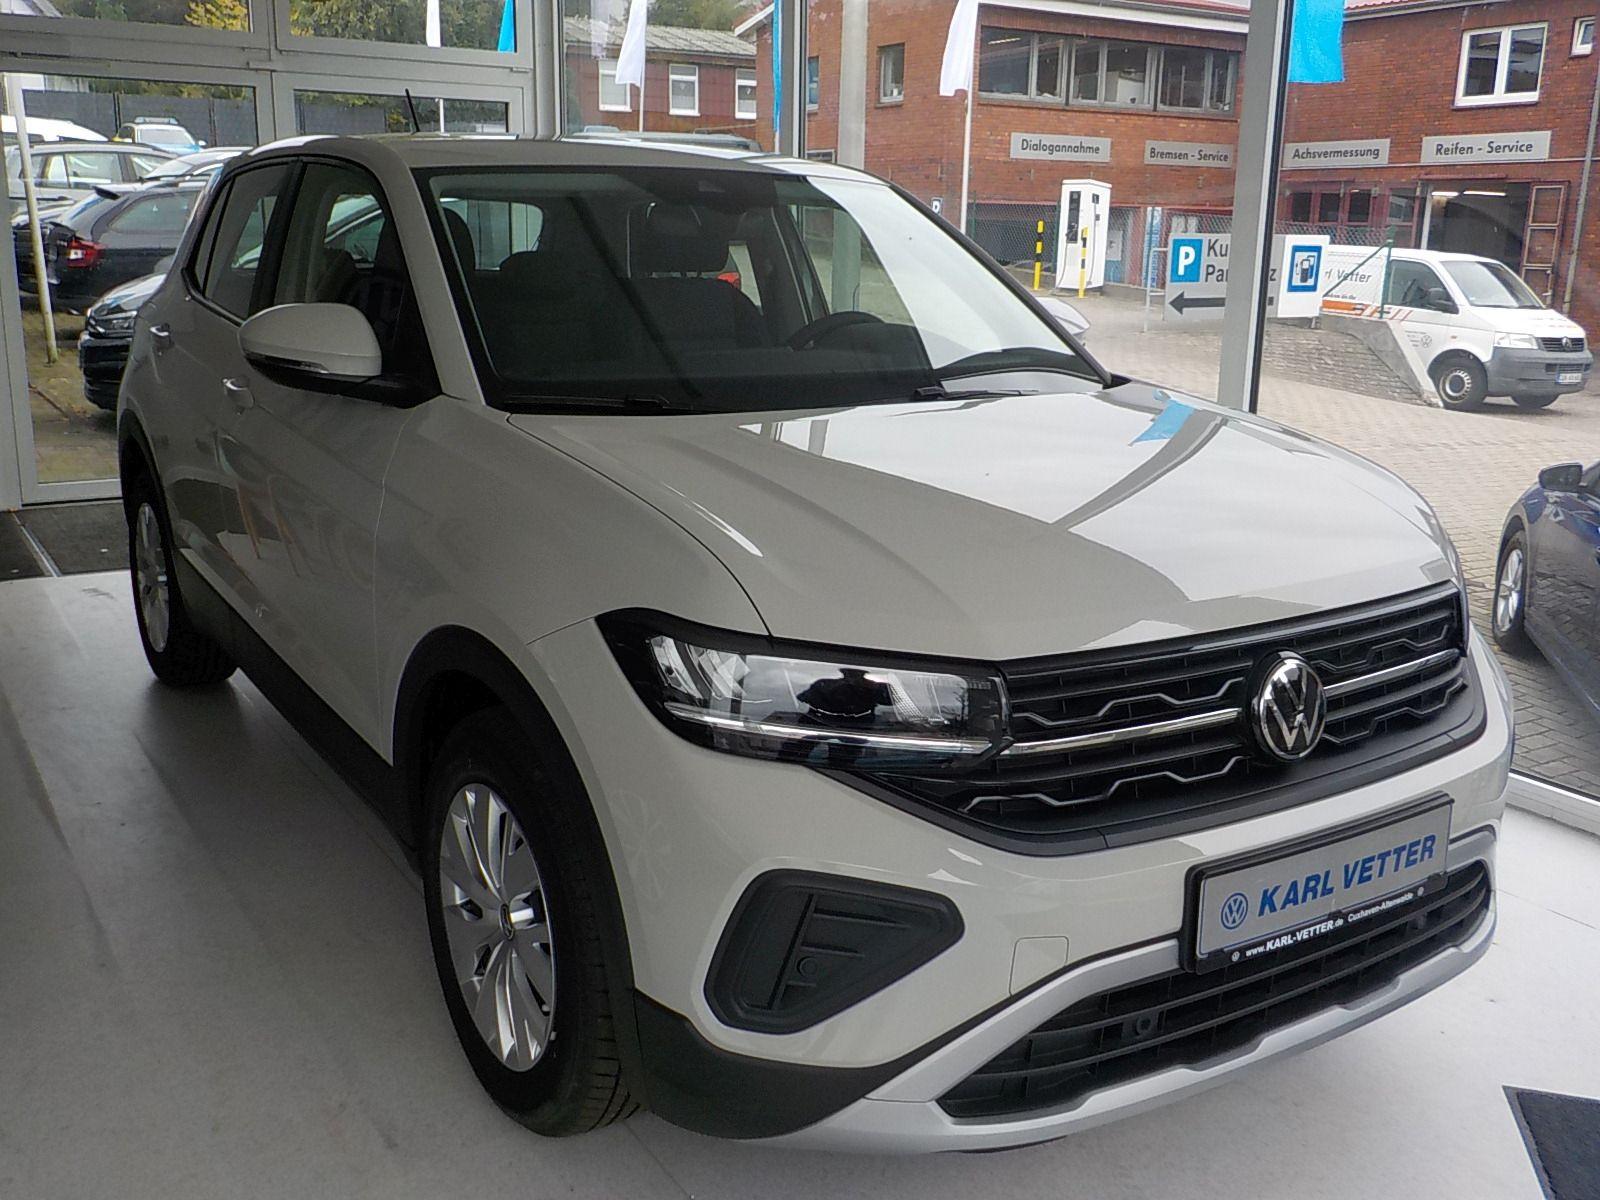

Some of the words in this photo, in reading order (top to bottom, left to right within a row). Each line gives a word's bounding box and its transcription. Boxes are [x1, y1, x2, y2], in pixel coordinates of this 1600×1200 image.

[1021, 138, 1100, 155] Dialogannahme
[1150, 147, 1189, 161] Bremsen
[1197, 149, 1229, 162] Service
[1292, 147, 1380, 160] Achsvermessung
[1435, 143, 1473, 156] Reifen
[1486, 140, 1533, 154] Service
[1207, 238, 1228, 257] Ku
[1178, 245, 1196, 276] P
[1258, 869, 1335, 917] KARL
[1343, 834, 1436, 889] VETTER
[1245, 917, 1344, 957] www.KARL-VETTER.de
